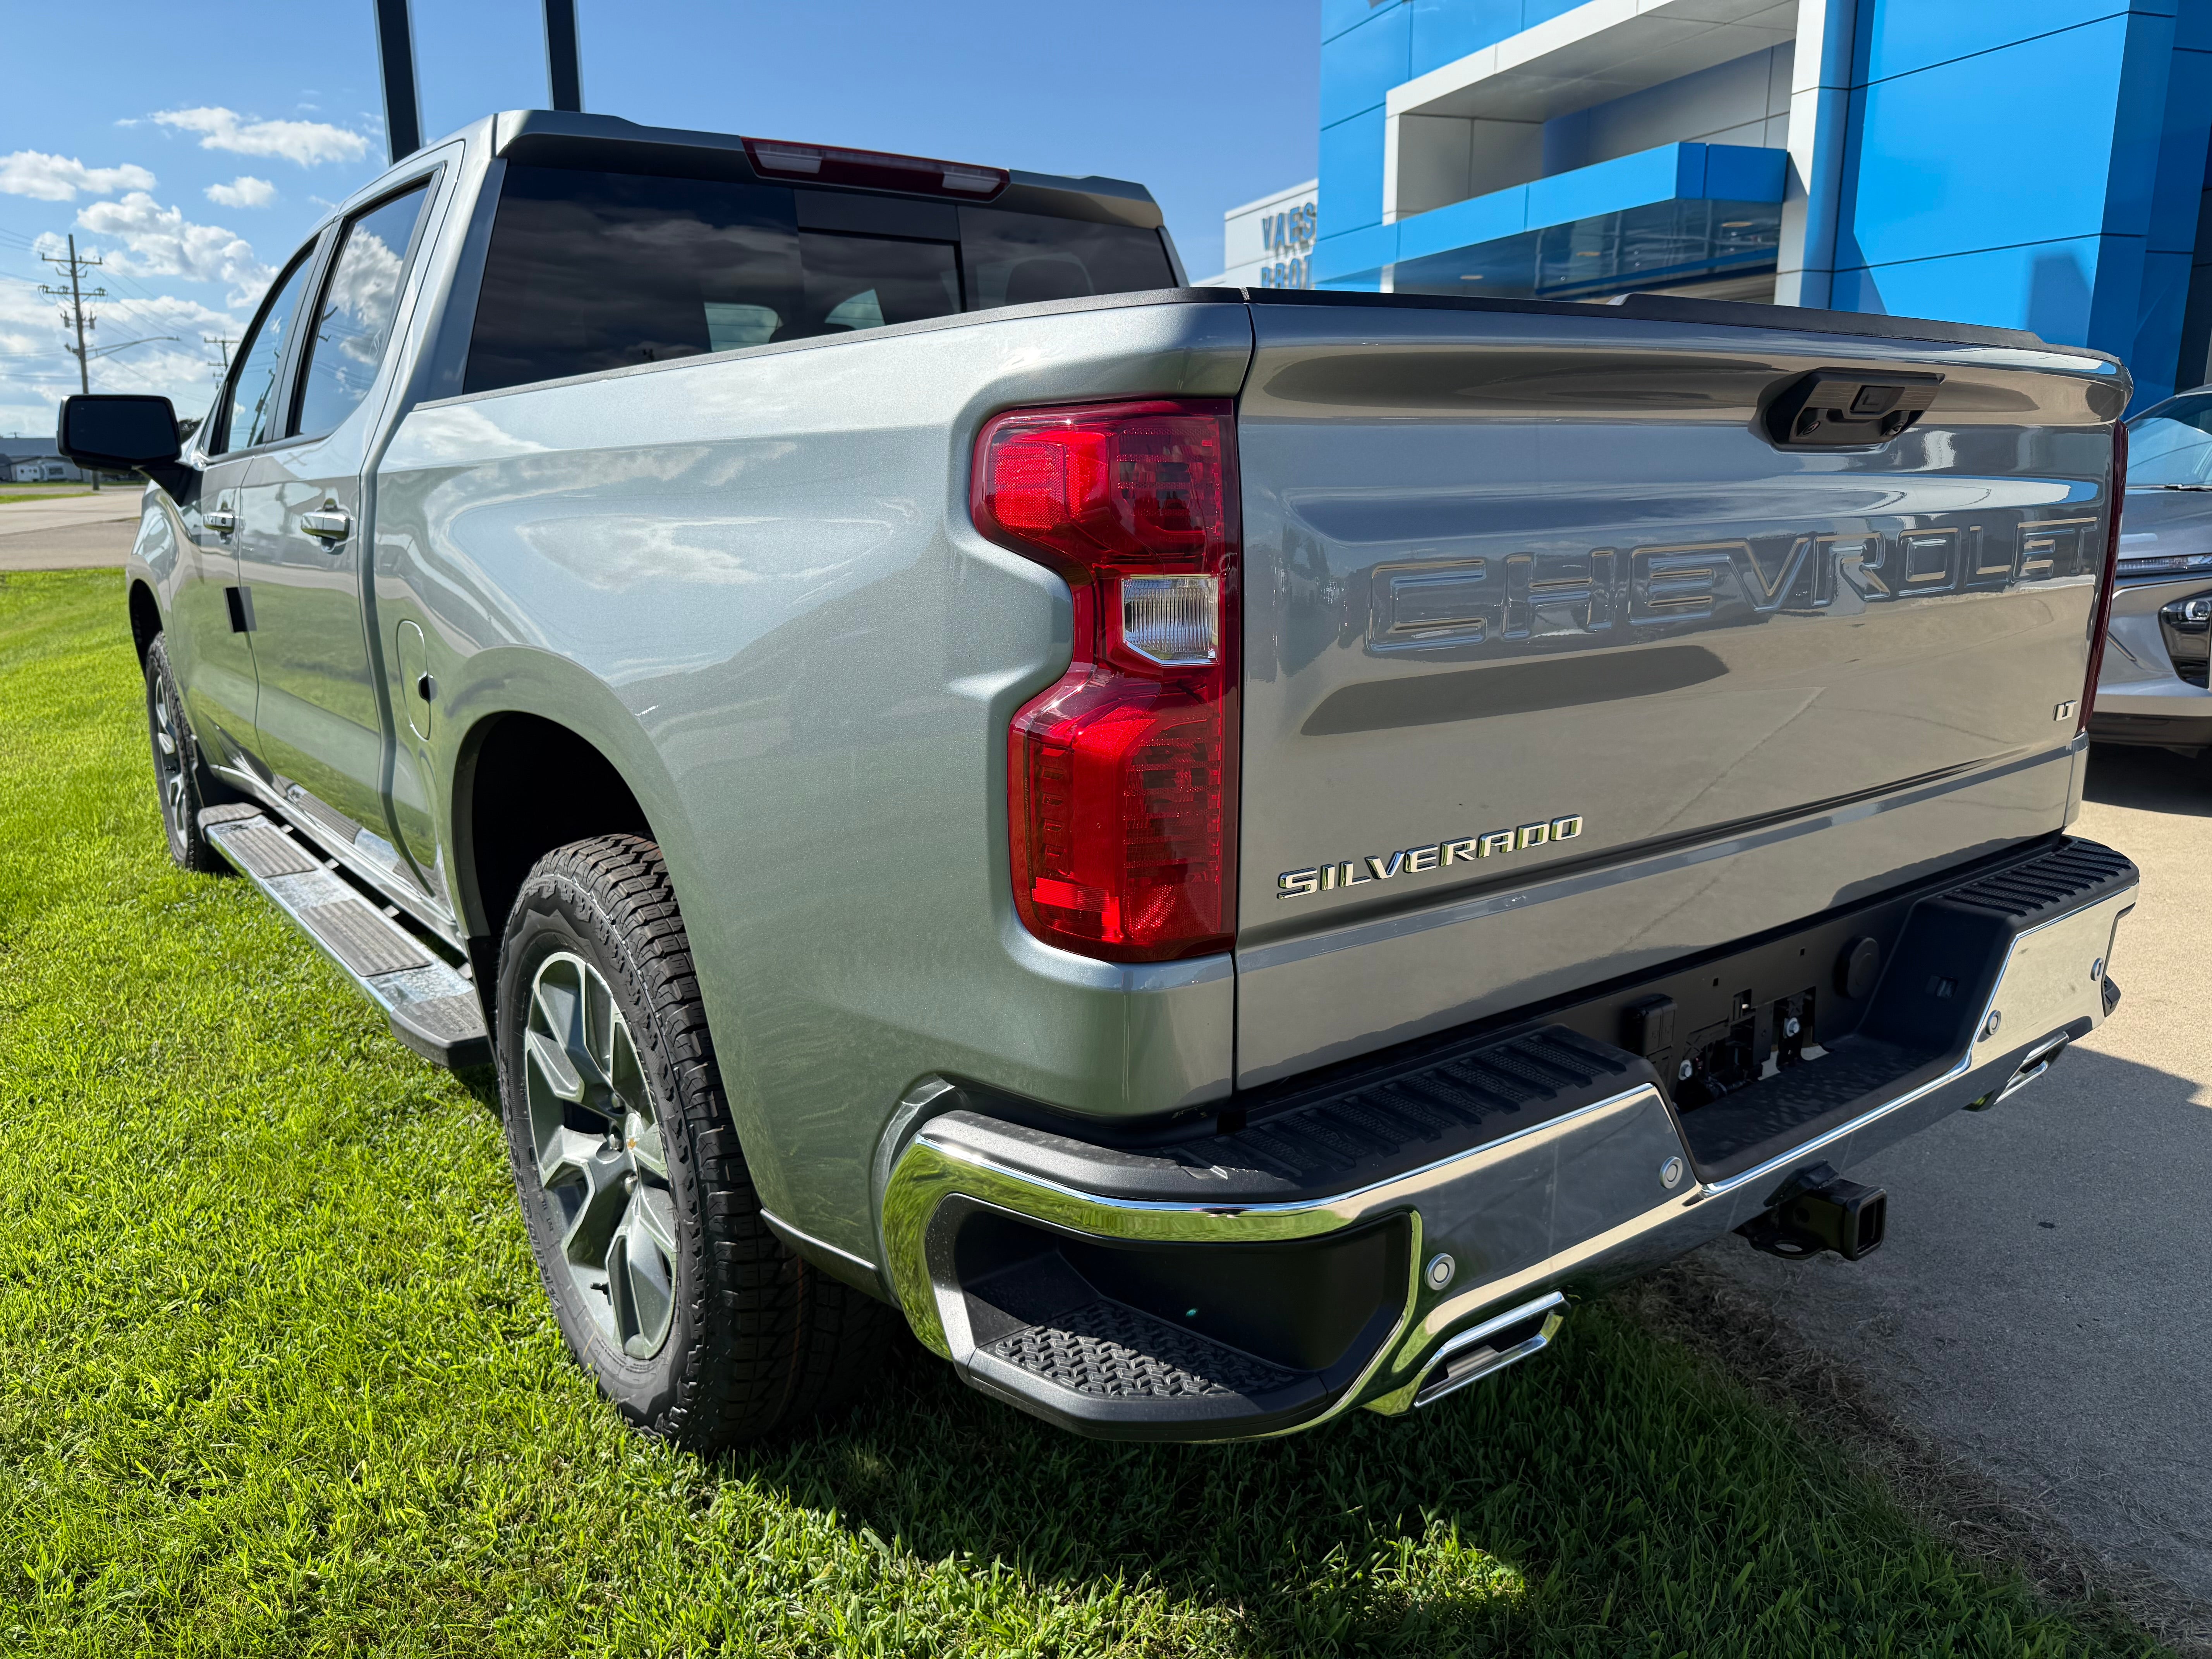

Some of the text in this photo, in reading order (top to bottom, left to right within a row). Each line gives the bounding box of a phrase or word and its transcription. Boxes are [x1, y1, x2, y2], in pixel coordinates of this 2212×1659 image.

[1366, 517, 2098, 652] CHEVROLET
[2053, 700, 2078, 721] LT
[1277, 814, 1583, 900] SILVERADO
